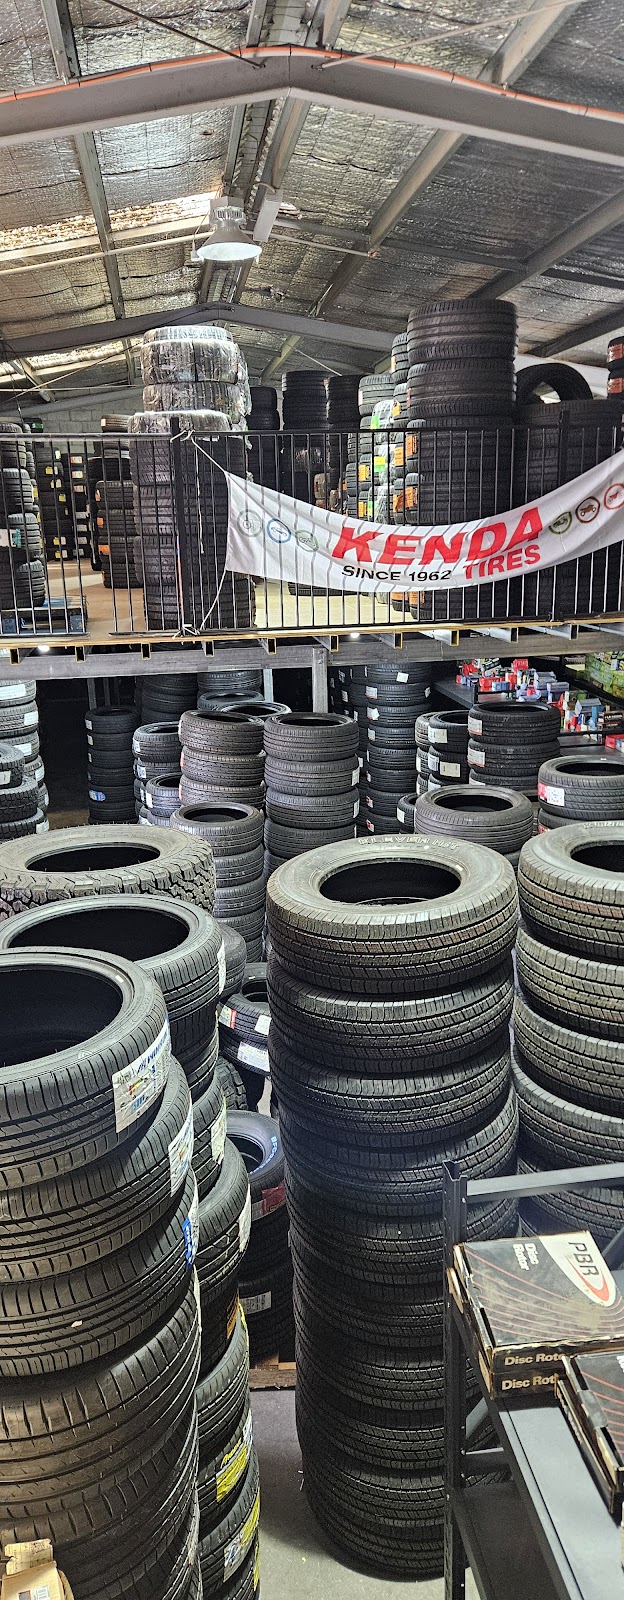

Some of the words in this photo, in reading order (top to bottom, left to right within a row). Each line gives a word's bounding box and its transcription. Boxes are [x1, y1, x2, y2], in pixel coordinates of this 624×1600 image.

[331, 506, 543, 566] KENDA
[341, 565, 401, 581] SINCE
[408, 569, 452, 582] 1962
[463, 544, 541, 580] TIRES
[512, 1243, 530, 1271] Rotor
[524, 1243, 540, 1265] Disc
[568, 1241, 600, 1276] PBR
[504, 1356, 534, 1366] Disc
[501, 1379, 531, 1390] Disc
[532, 1375, 556, 1386] Rot
